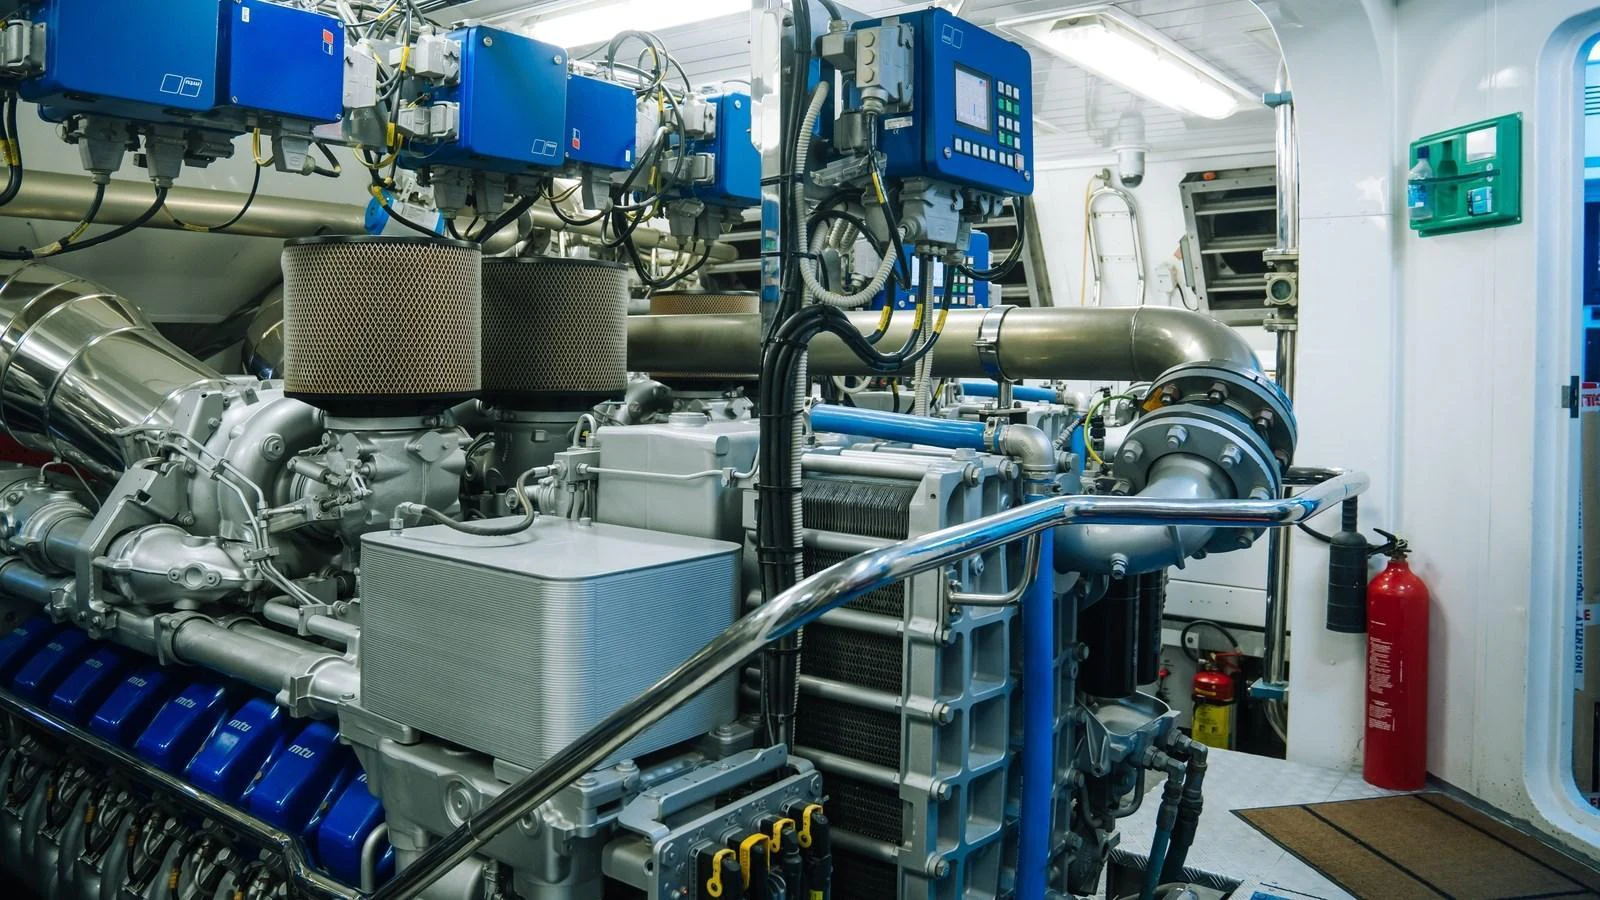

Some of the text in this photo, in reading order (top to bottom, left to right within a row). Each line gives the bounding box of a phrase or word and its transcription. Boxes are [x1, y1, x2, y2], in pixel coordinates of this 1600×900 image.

[127, 676, 147, 687] mtu
[175, 696, 197, 709] mtu
[227, 719, 252, 732] mtu
[288, 744, 315, 759] mtu
